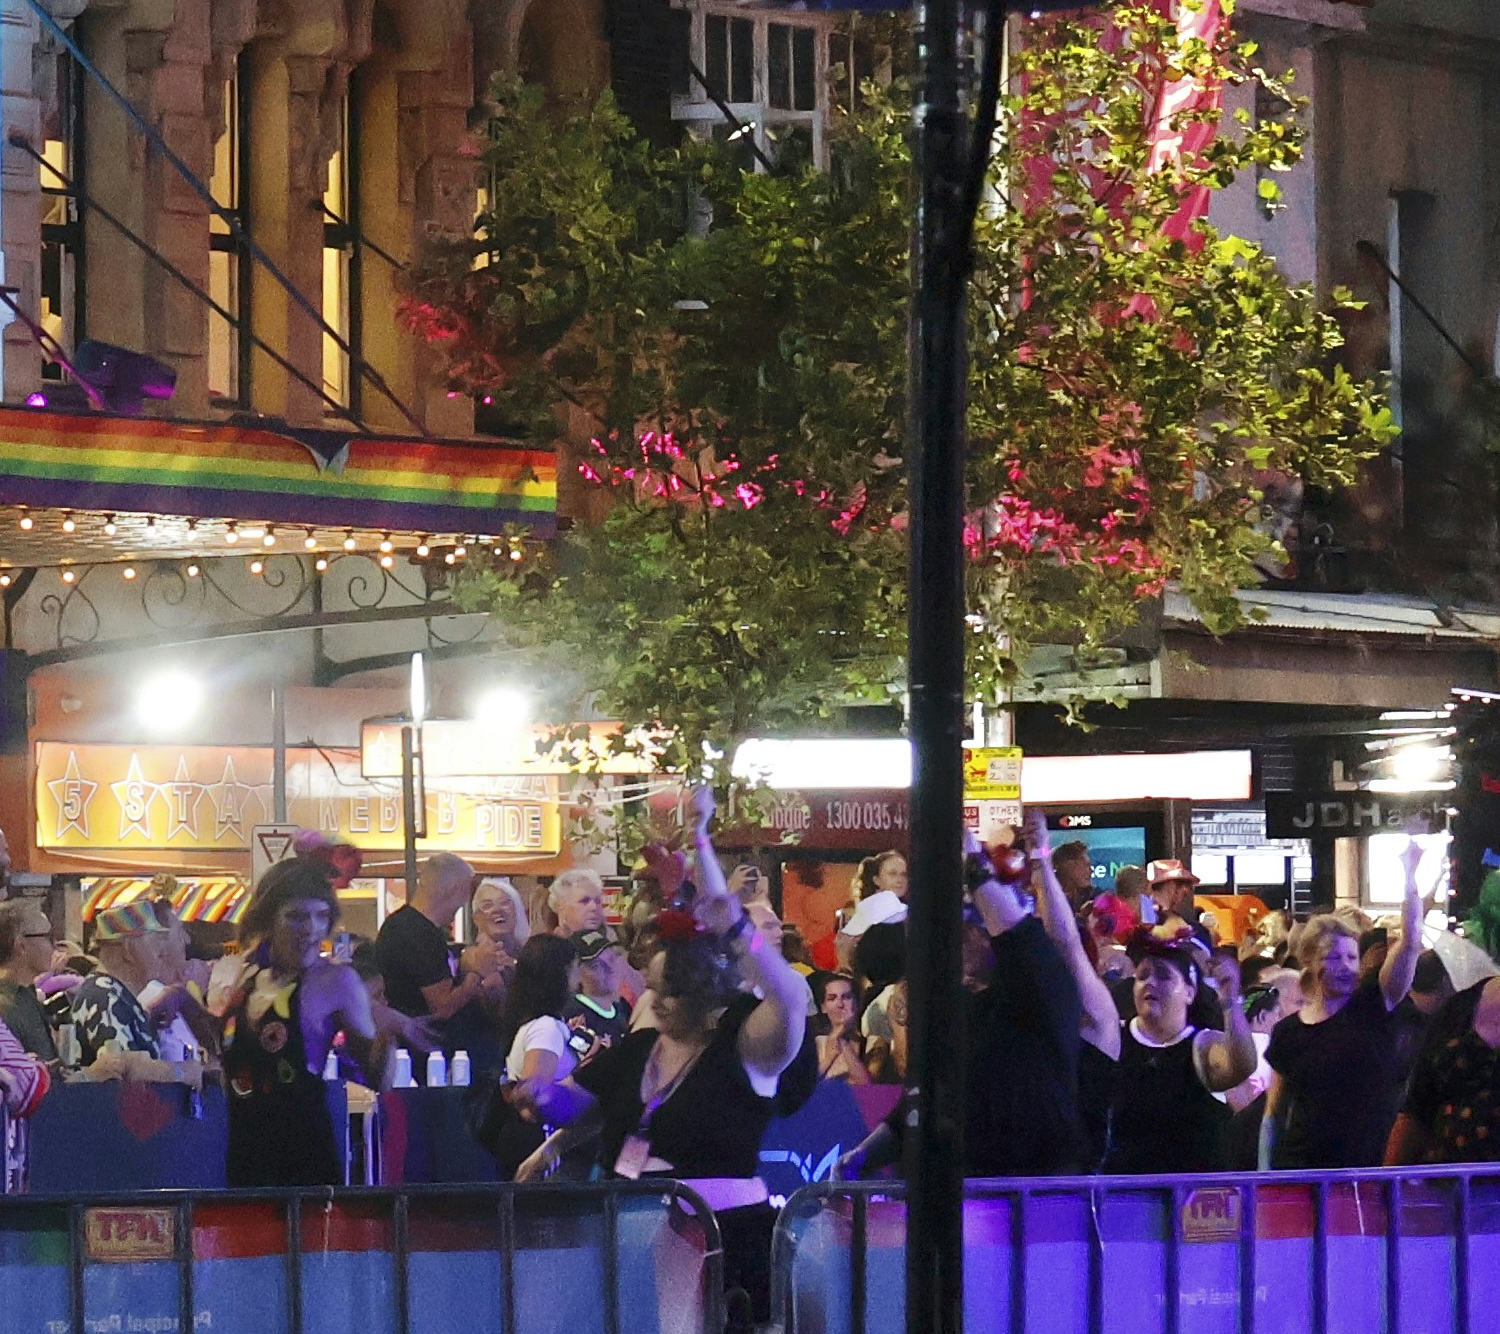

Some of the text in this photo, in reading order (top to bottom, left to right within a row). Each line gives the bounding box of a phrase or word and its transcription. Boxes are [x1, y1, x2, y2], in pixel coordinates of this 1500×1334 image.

[125, 782, 278, 824] STA
[317, 775, 458, 835] KEBB
[475, 803, 543, 848] PIDE
